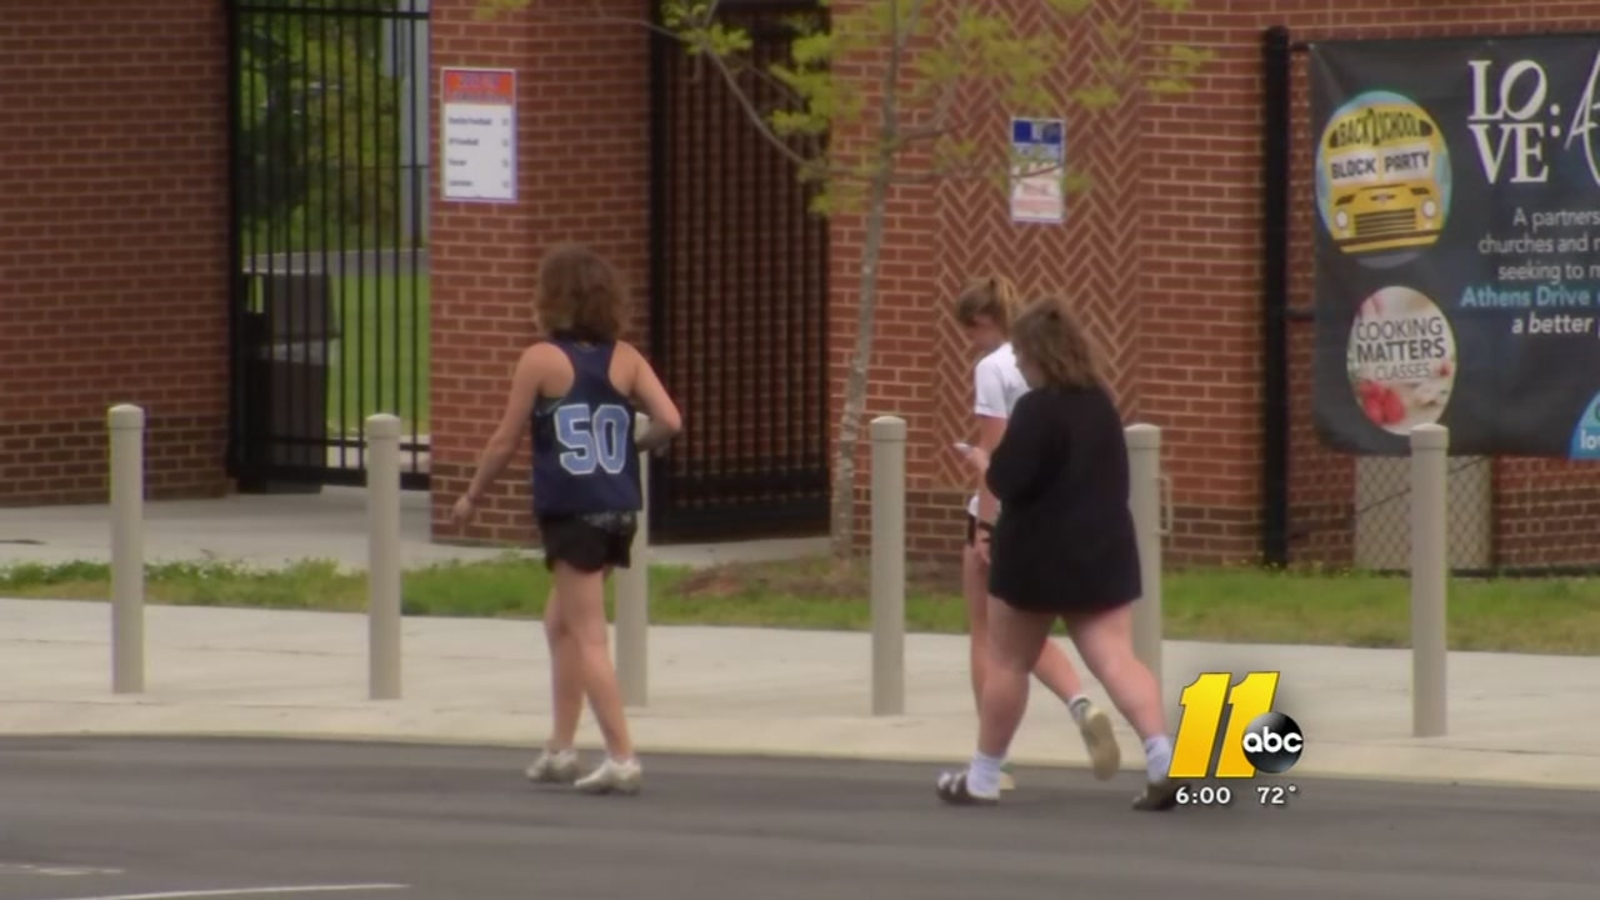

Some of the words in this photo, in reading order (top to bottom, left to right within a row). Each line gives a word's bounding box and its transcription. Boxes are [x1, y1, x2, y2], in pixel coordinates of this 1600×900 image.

[1331, 158, 1377, 180] BLOCK
[1384, 150, 1431, 174] PARTY
[1512, 206, 1528, 227] A
[1478, 232, 1554, 254] churches
[1557, 232, 1588, 252] and
[1498, 258, 1561, 286] seeking
[1565, 263, 1585, 280] to
[1460, 285, 1532, 308] Athens
[1536, 285, 1591, 307] Drive
[1356, 316, 1443, 342] COOKING
[1511, 318, 1523, 334] a
[1528, 311, 1594, 334] better
[1356, 337, 1446, 363] MATTERS
[1374, 362, 1431, 381] CLASSES
[554, 403, 630, 475] 50
